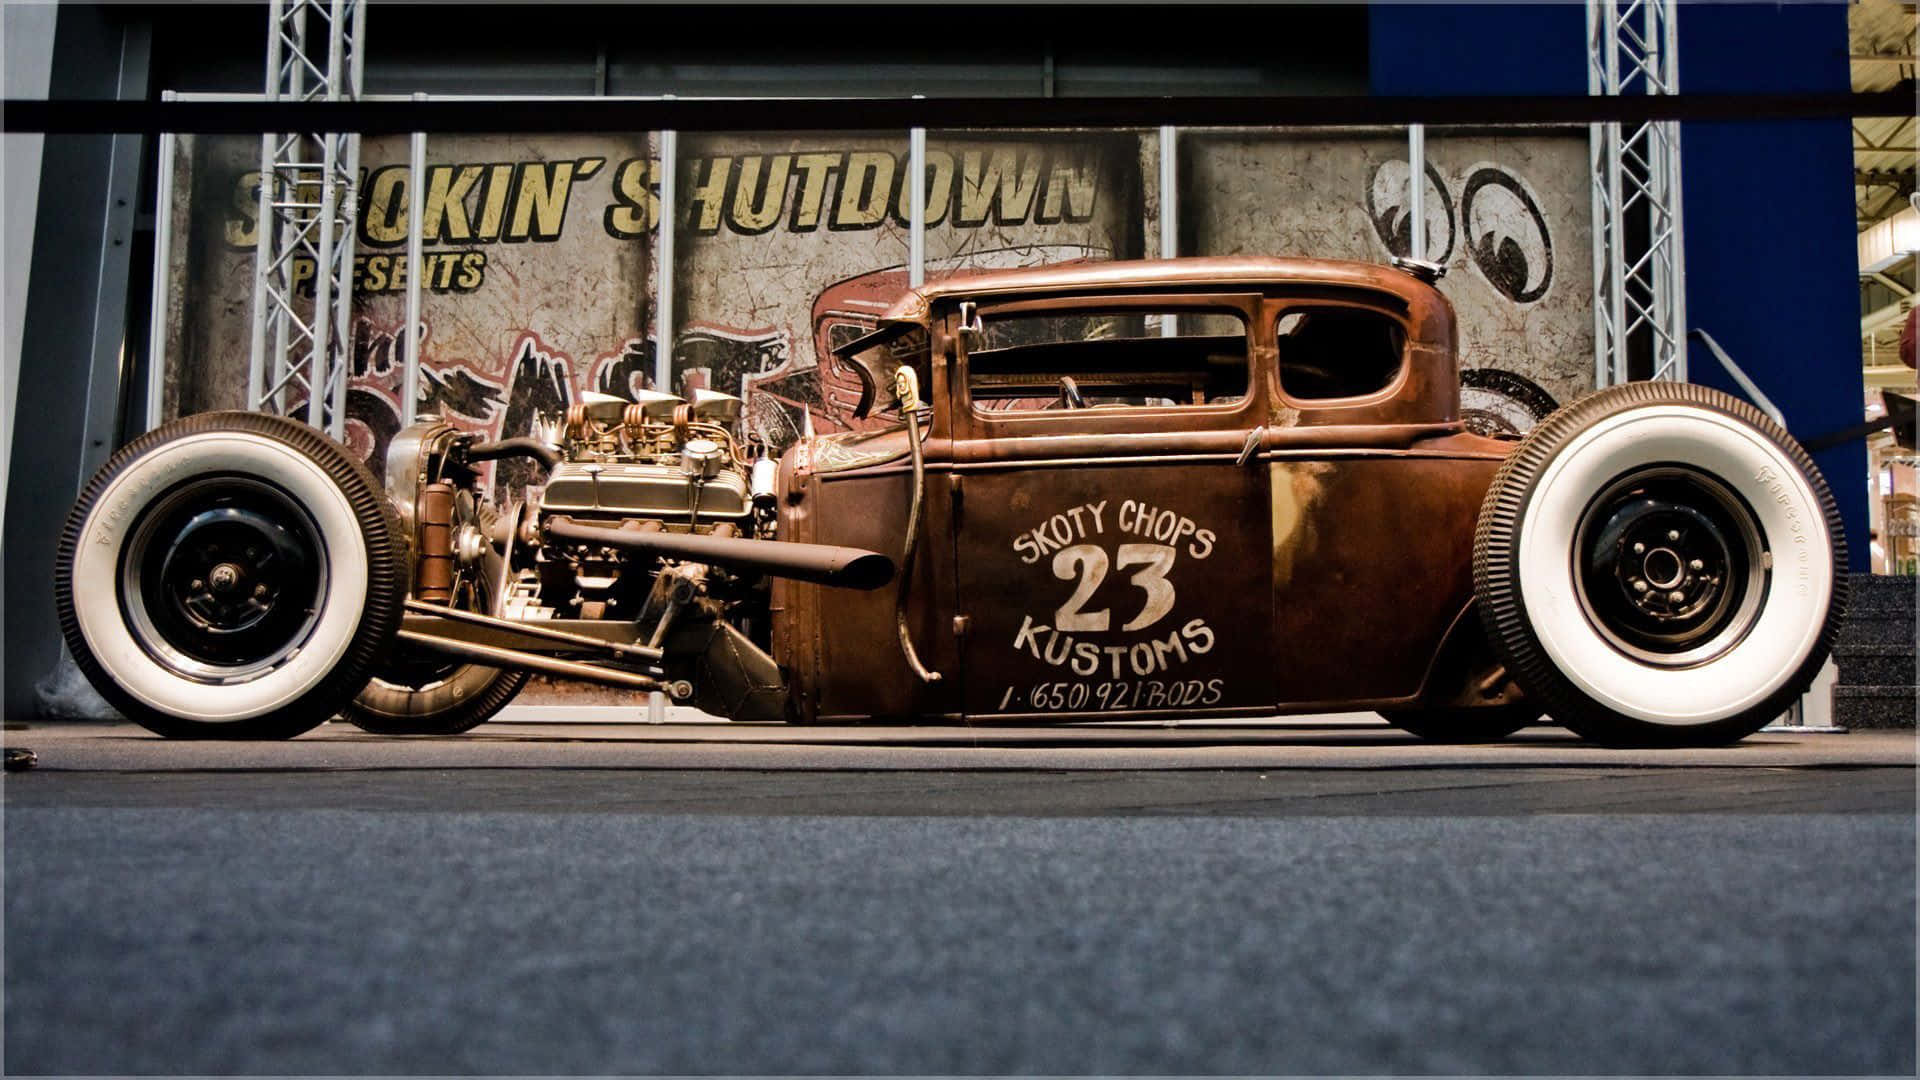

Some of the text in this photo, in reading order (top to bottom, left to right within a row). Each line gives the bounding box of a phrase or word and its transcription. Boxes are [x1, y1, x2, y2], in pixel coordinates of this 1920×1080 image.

[603, 149, 1100, 240] SHUTDOWN
[292, 250, 487, 294] PESENTS
[1013, 499, 1217, 564] SKOTY CHOPS
[1052, 543, 1177, 633] 23
[1013, 614, 1216, 679] KUSTOMS
